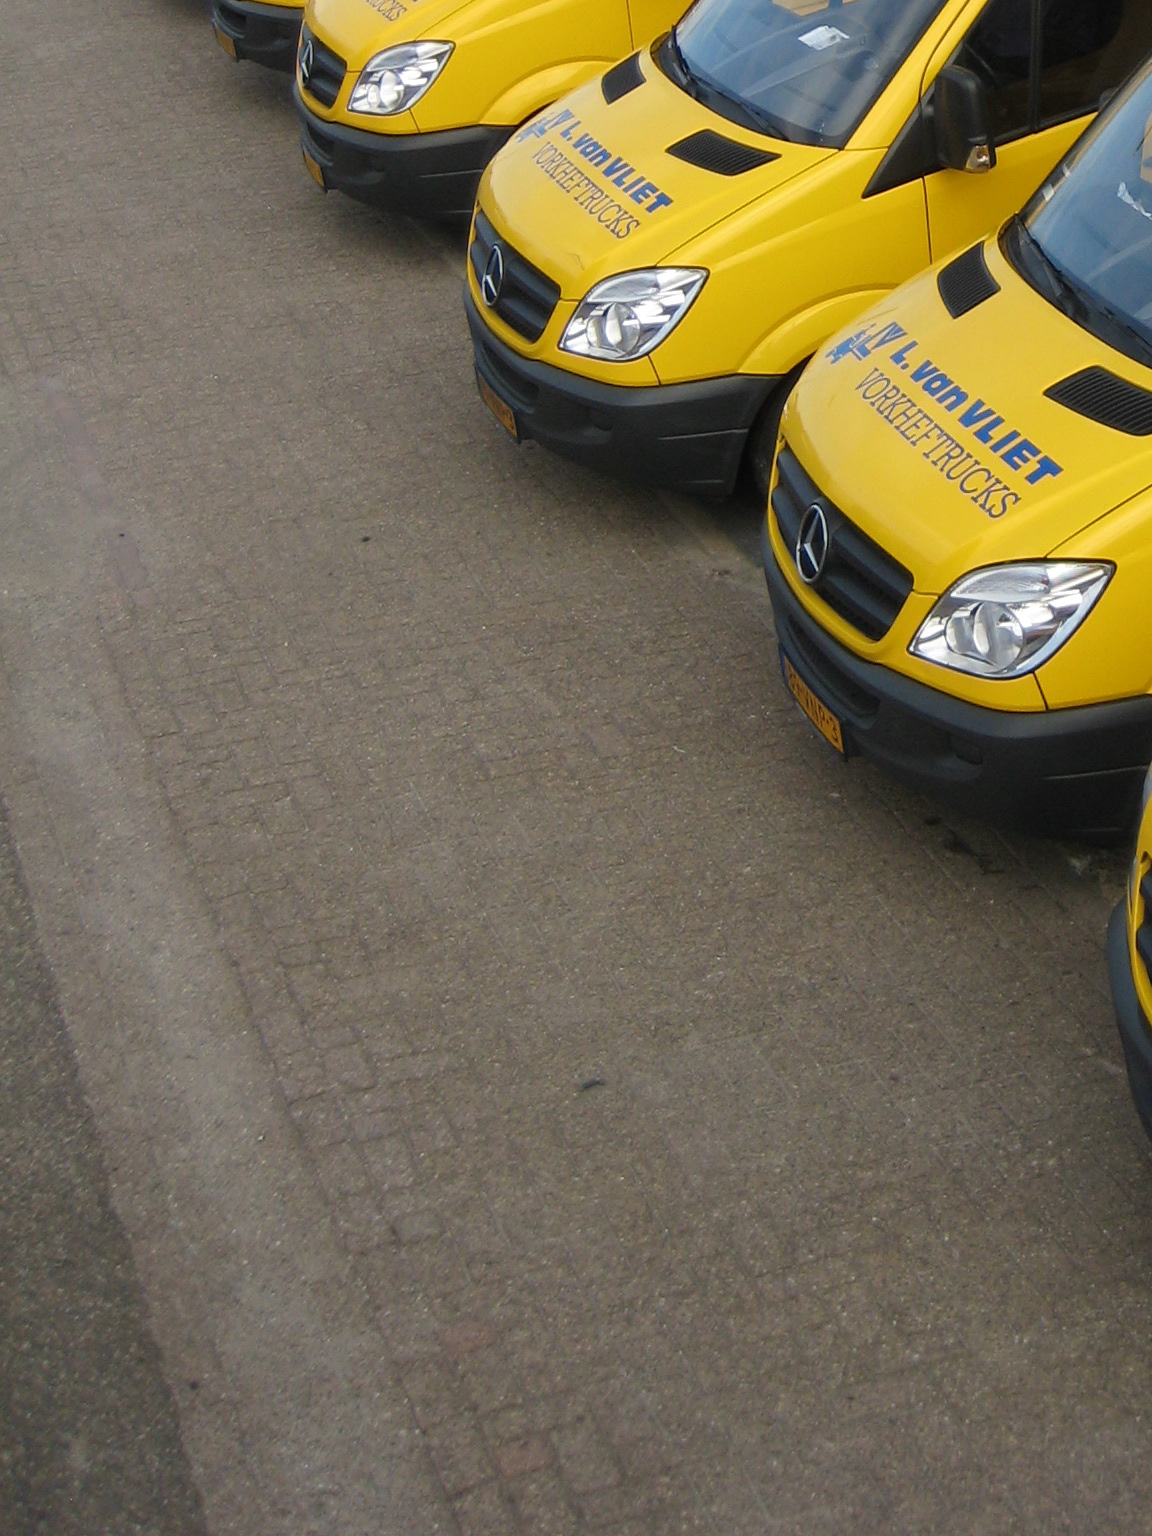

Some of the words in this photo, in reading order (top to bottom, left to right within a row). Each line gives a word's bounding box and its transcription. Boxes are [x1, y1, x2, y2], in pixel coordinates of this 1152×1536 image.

[532, 142, 640, 239] VORKHEFTRUCKS
[560, 120, 581, 142] L.
[572, 133, 612, 167] van
[602, 156, 673, 213] VLIET
[855, 368, 1022, 519] VORKHEFTRUCKS
[890, 340, 918, 370] L.
[910, 360, 970, 412] van
[958, 399, 1064, 485] VLIET
